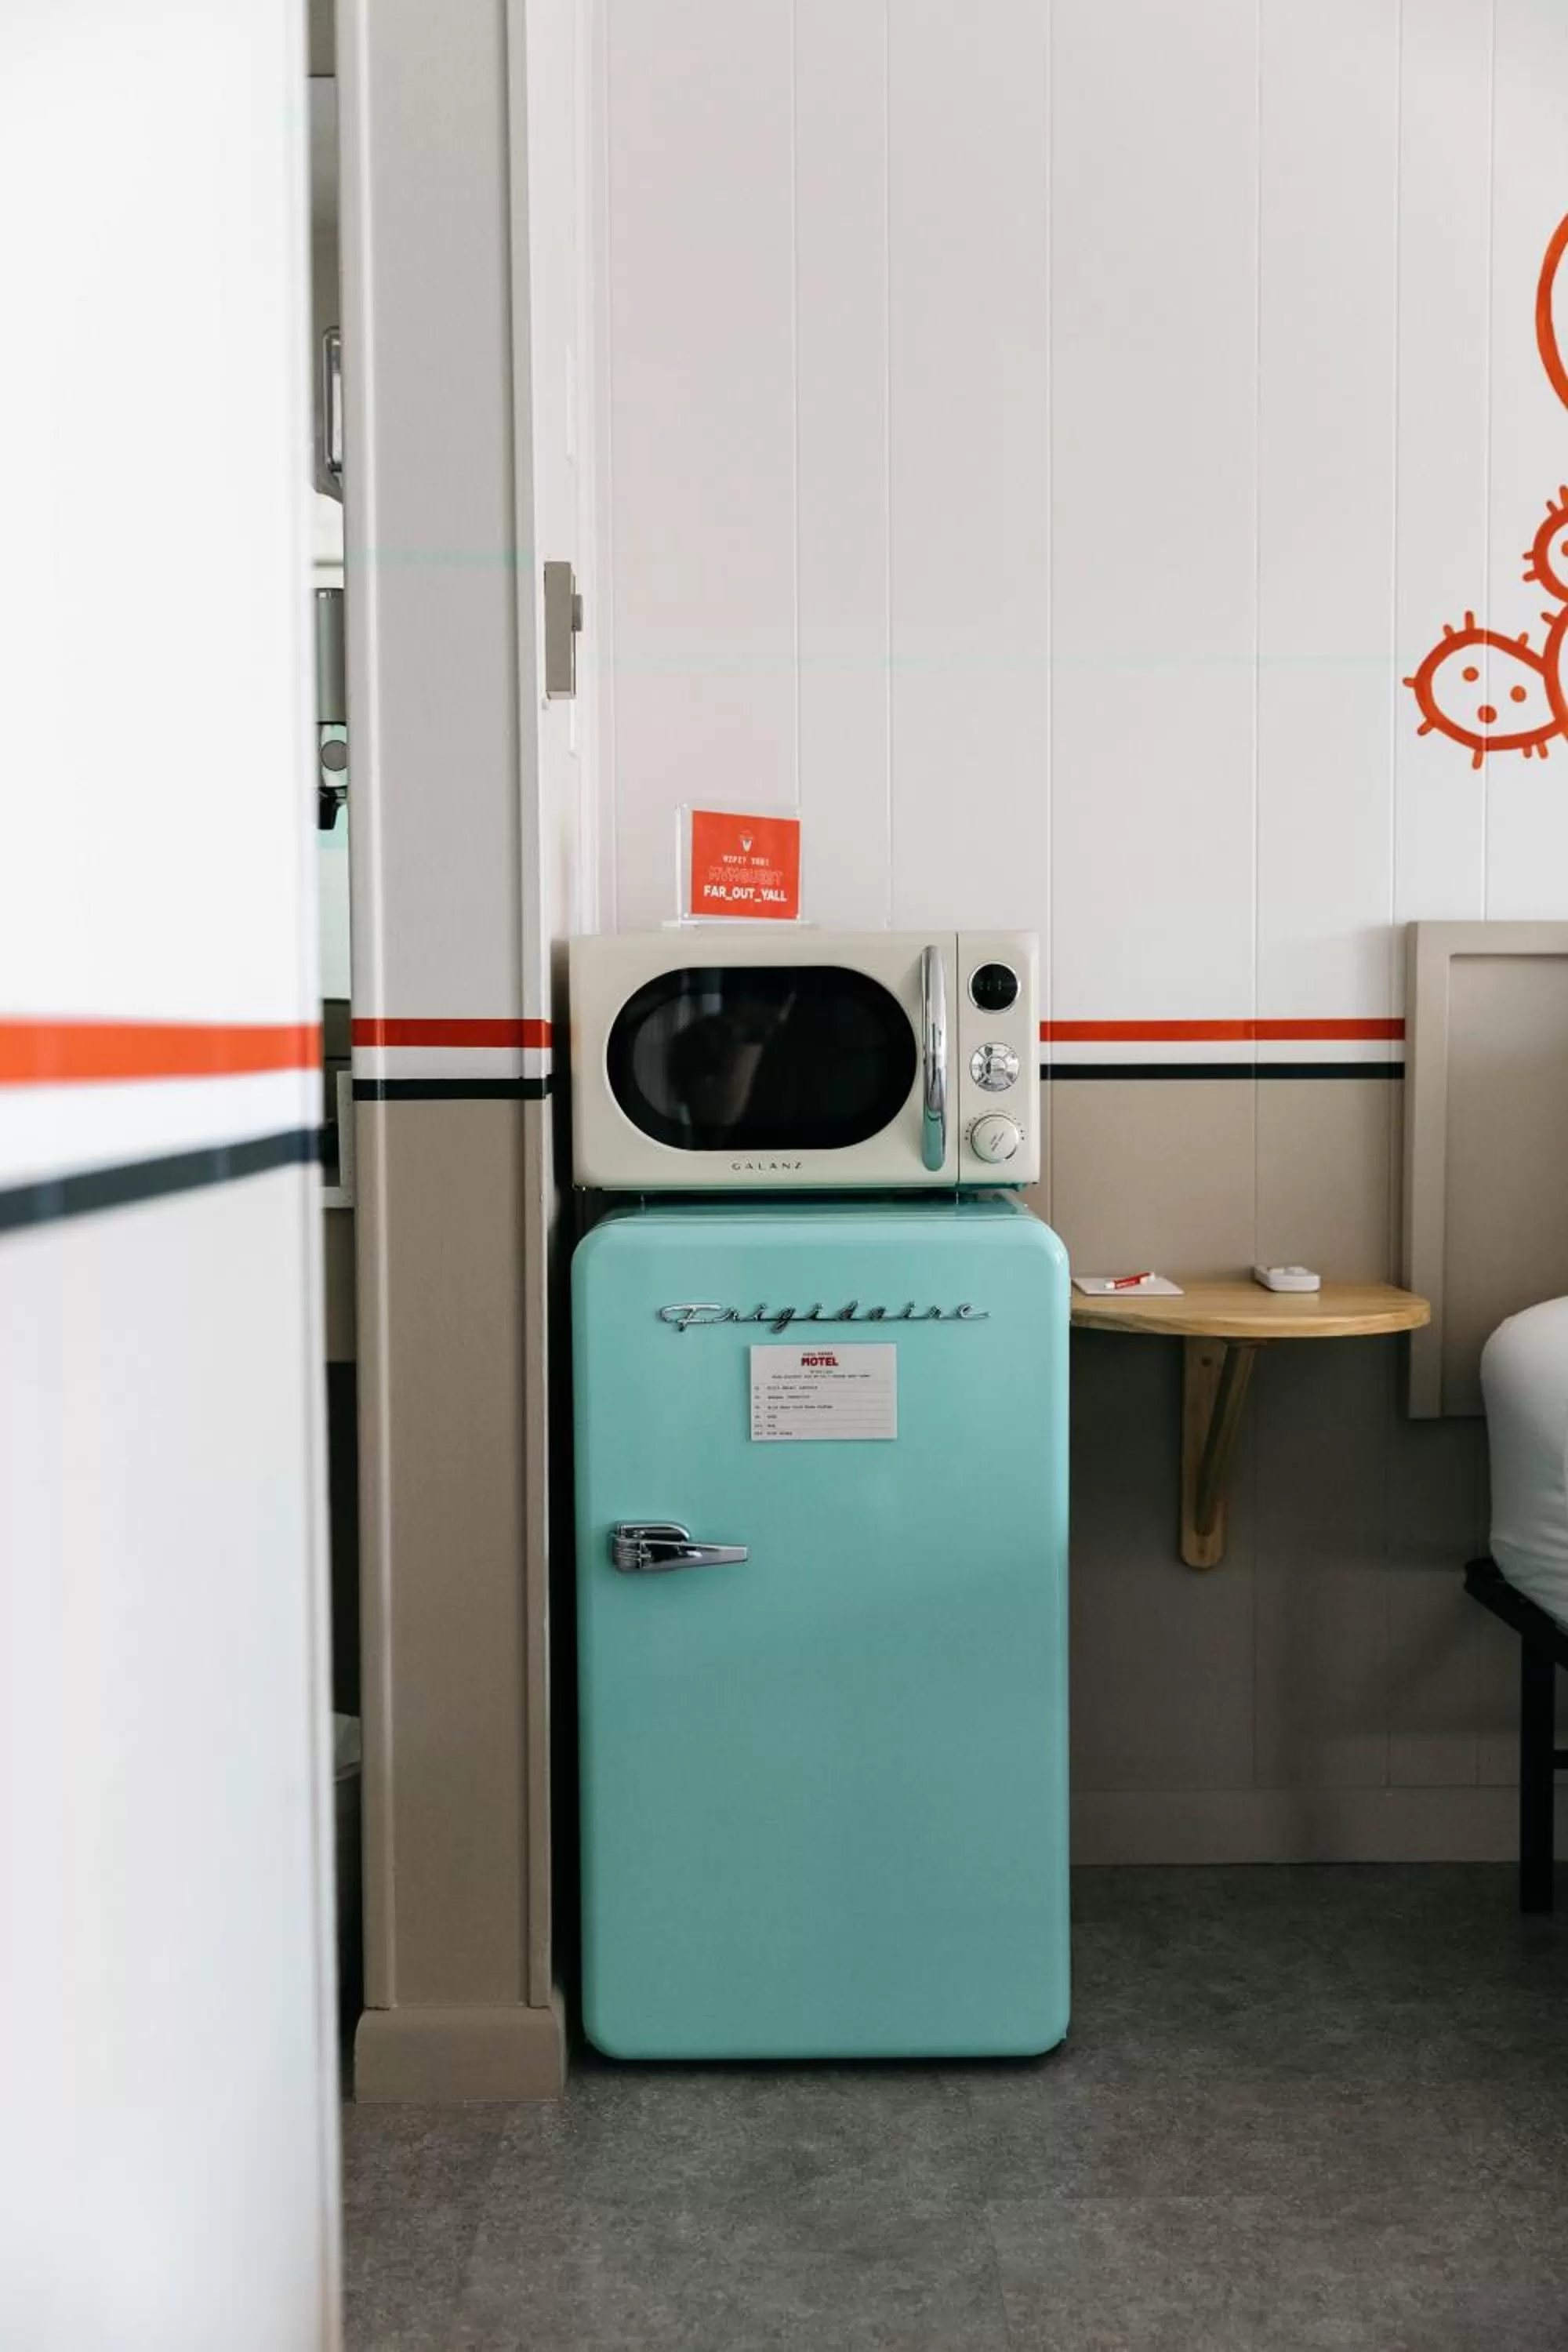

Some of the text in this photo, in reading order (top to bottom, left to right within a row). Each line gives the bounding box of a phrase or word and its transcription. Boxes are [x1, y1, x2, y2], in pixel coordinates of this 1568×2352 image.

[731, 1162, 802, 1171] GALANZ
[659, 1301, 992, 1334] Frigidaire
[800, 1357, 839, 1367] MOTEL
